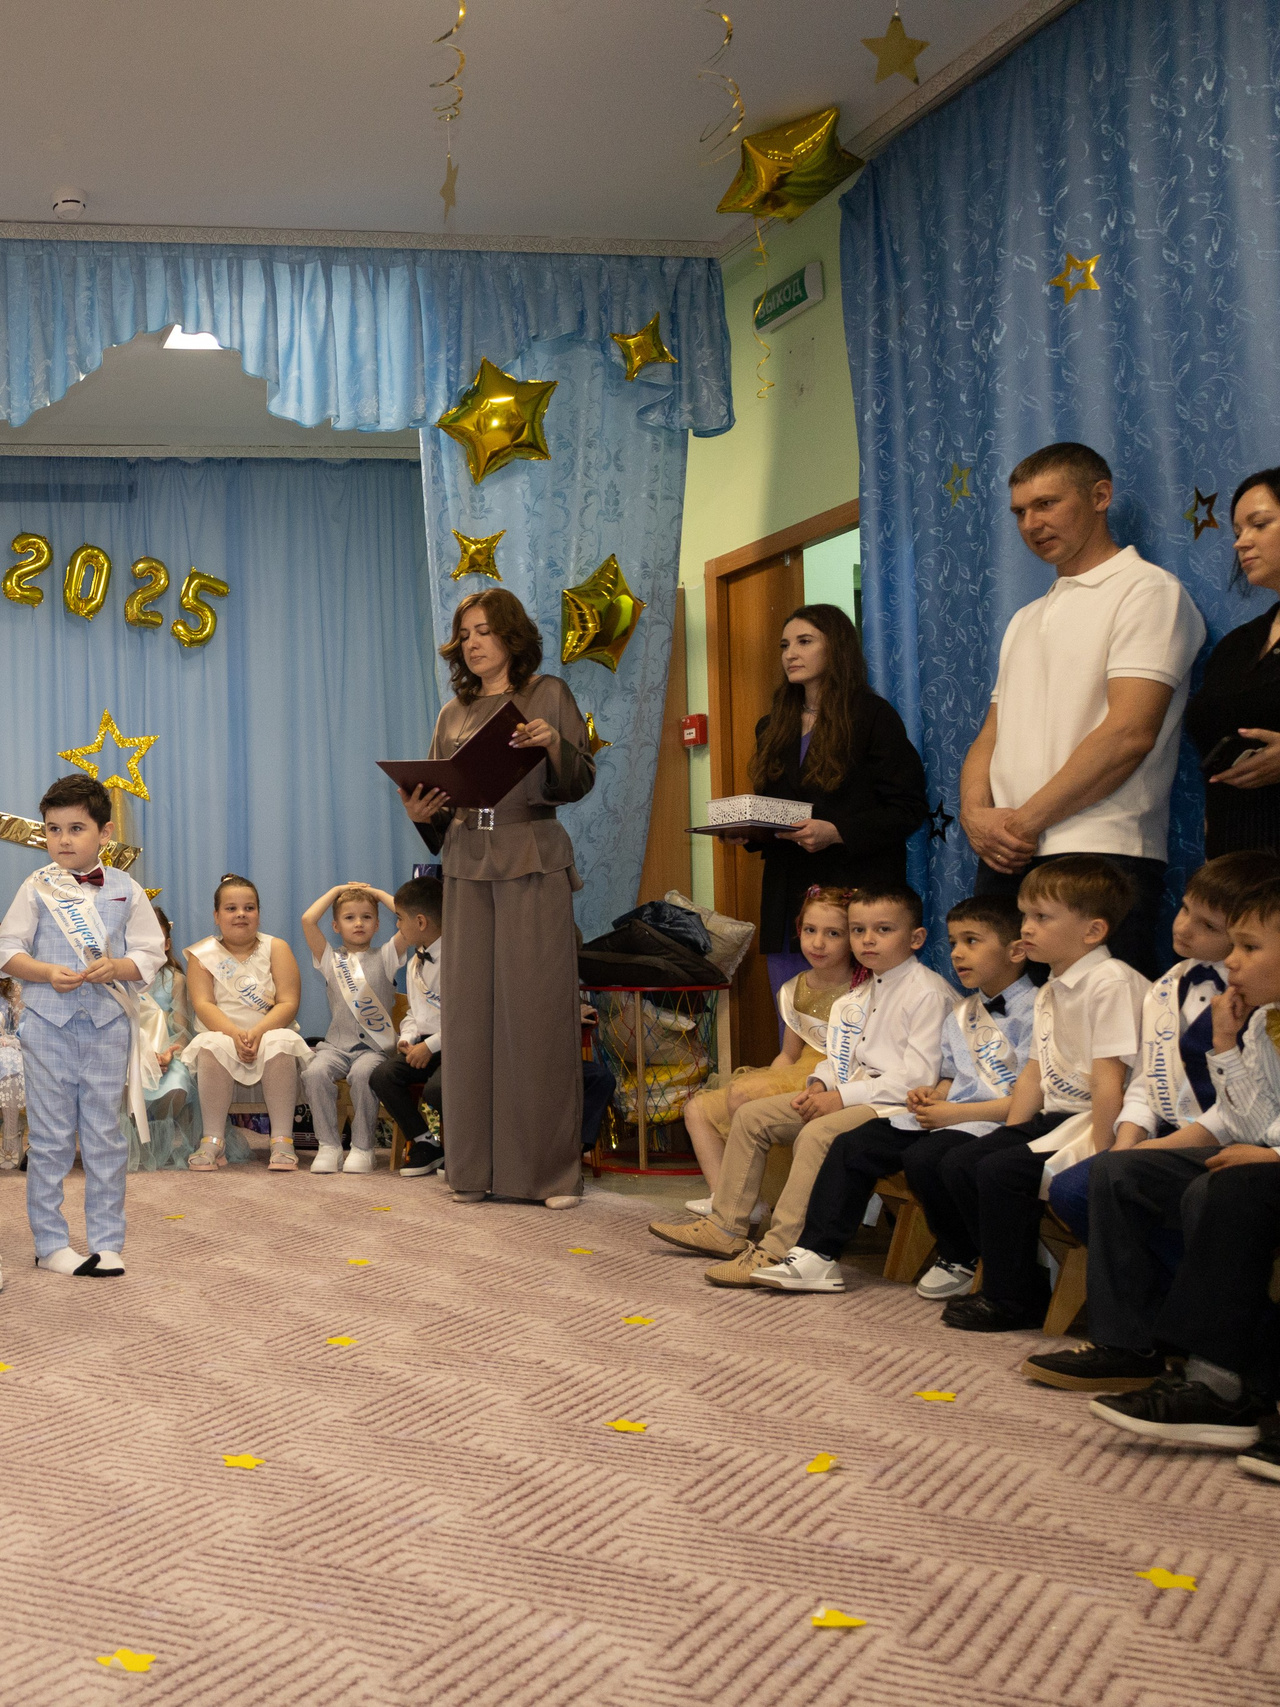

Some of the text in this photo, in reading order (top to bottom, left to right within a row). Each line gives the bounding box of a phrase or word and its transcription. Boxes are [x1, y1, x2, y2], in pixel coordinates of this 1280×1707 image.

[759, 278, 803, 319] ВЫХОД
[1, 531, 231, 649] 2025
[352, 997, 391, 1032] 2025
